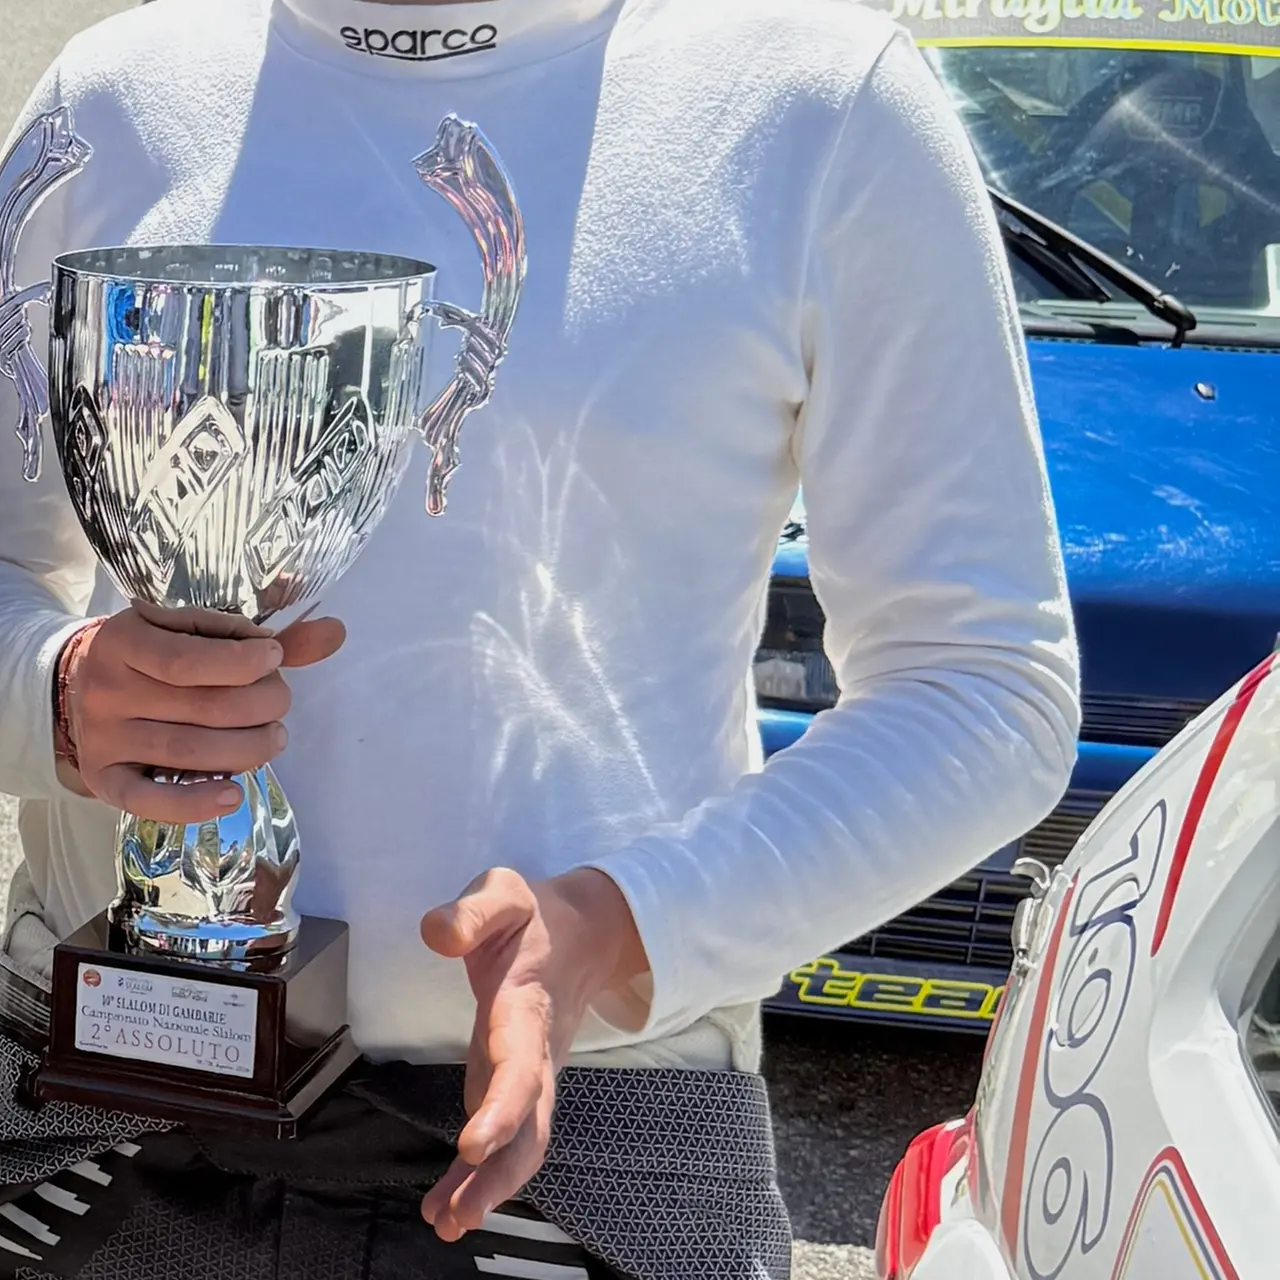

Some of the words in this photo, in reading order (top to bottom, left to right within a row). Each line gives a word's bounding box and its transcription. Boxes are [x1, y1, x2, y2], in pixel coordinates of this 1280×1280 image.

[340, 23, 498, 61] sparco
[116, 996, 157, 1015] SLALOM
[159, 1003, 170, 1016] DI
[91, 1022, 112, 1041] 2°
[114, 1027, 241, 1063] ASSOLUTO
